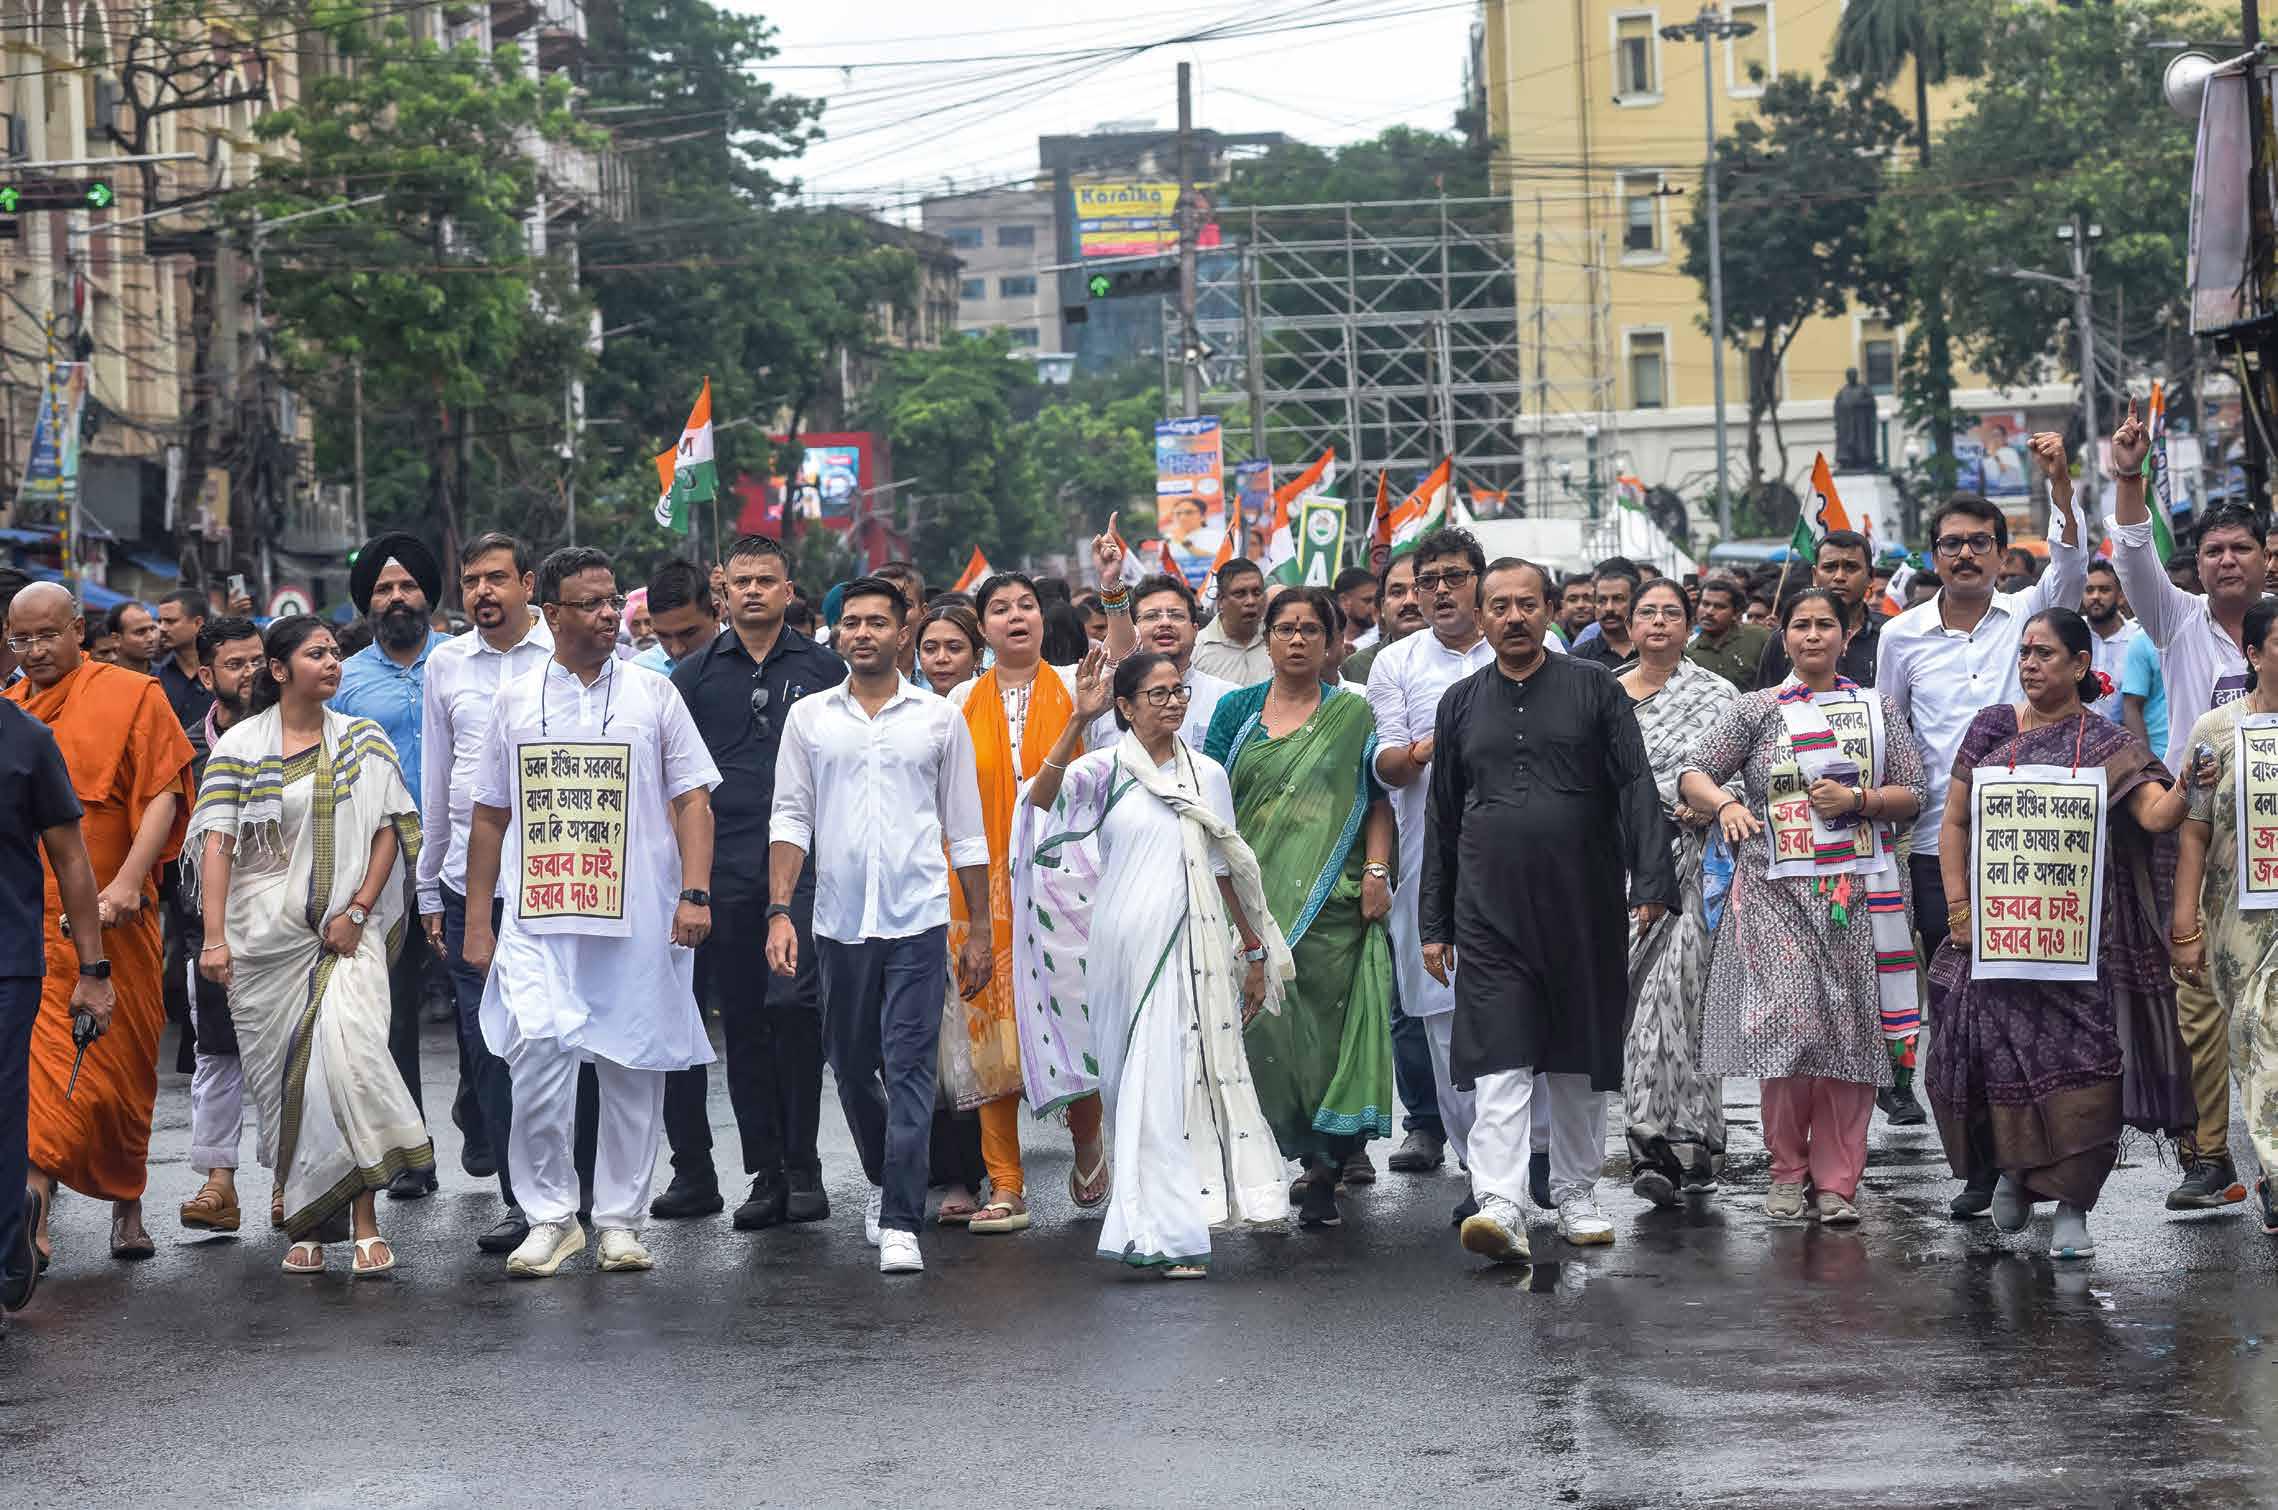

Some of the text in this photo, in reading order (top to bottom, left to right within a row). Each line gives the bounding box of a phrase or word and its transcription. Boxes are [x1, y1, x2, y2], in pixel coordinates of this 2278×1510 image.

[1842, 738, 1868, 759] কথা
[525, 749, 625, 783] ডবল ইঞ্জিন সরকার,
[1772, 774, 1793, 793] বলা
[526, 788, 622, 812] বাংলা ভাষায় কথা
[1985, 788, 2093, 822] ডবল ইঞ্জিন সরকার,
[549, 814, 563, 843] কি
[567, 820, 610, 844] অপরাধ
[613, 823, 621, 844] ?
[1986, 829, 2090, 854] বাংলা ভাষায় কথা
[527, 847, 618, 882] জবাব চাই,
[1986, 855, 2089, 887] বলা কি অপরাধ ?
[526, 882, 617, 912] জবাব দাও !!
[1985, 890, 2086, 926] জবাব চাই,
[1985, 926, 2084, 958] জবাব দাও !!
